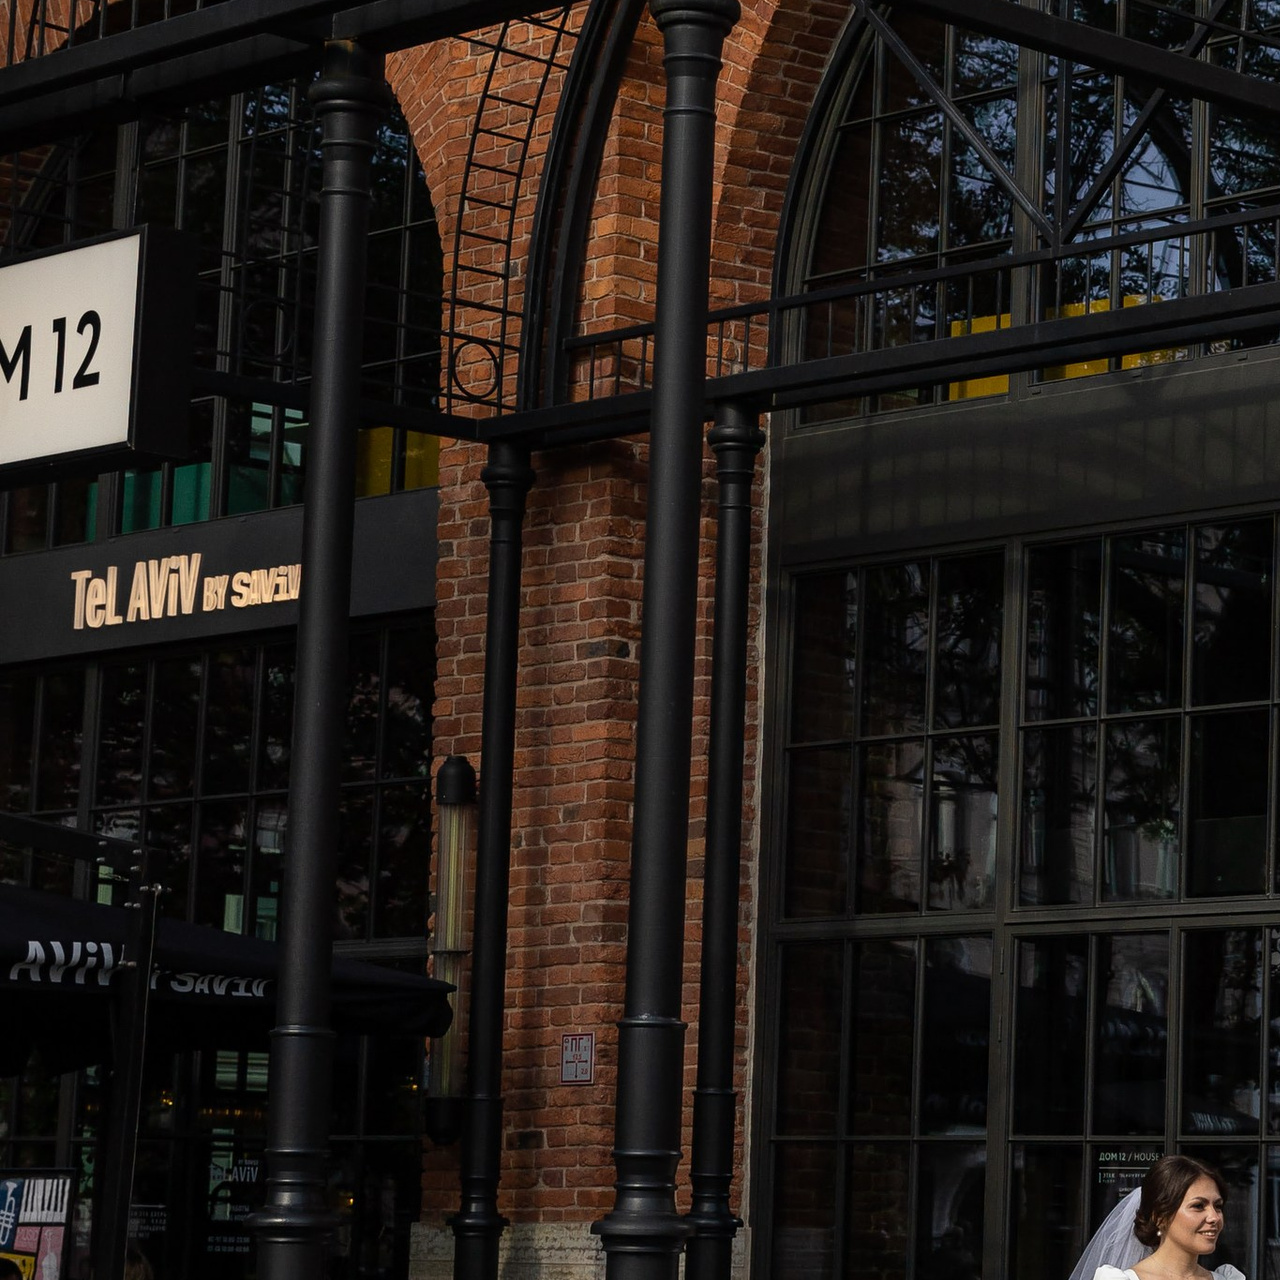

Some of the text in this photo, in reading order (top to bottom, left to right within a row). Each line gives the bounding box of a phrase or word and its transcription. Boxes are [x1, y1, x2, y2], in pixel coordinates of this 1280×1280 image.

[52, 309, 101, 394] 12
[70, 566, 123, 629] TeL
[126, 553, 201, 622] AViV
[202, 575, 229, 611] BY
[1098, 1151, 1118, 1162] ДОМ
[1118, 1152, 1126, 1161] 12
[1134, 1152, 1160, 1161] HOUSE
